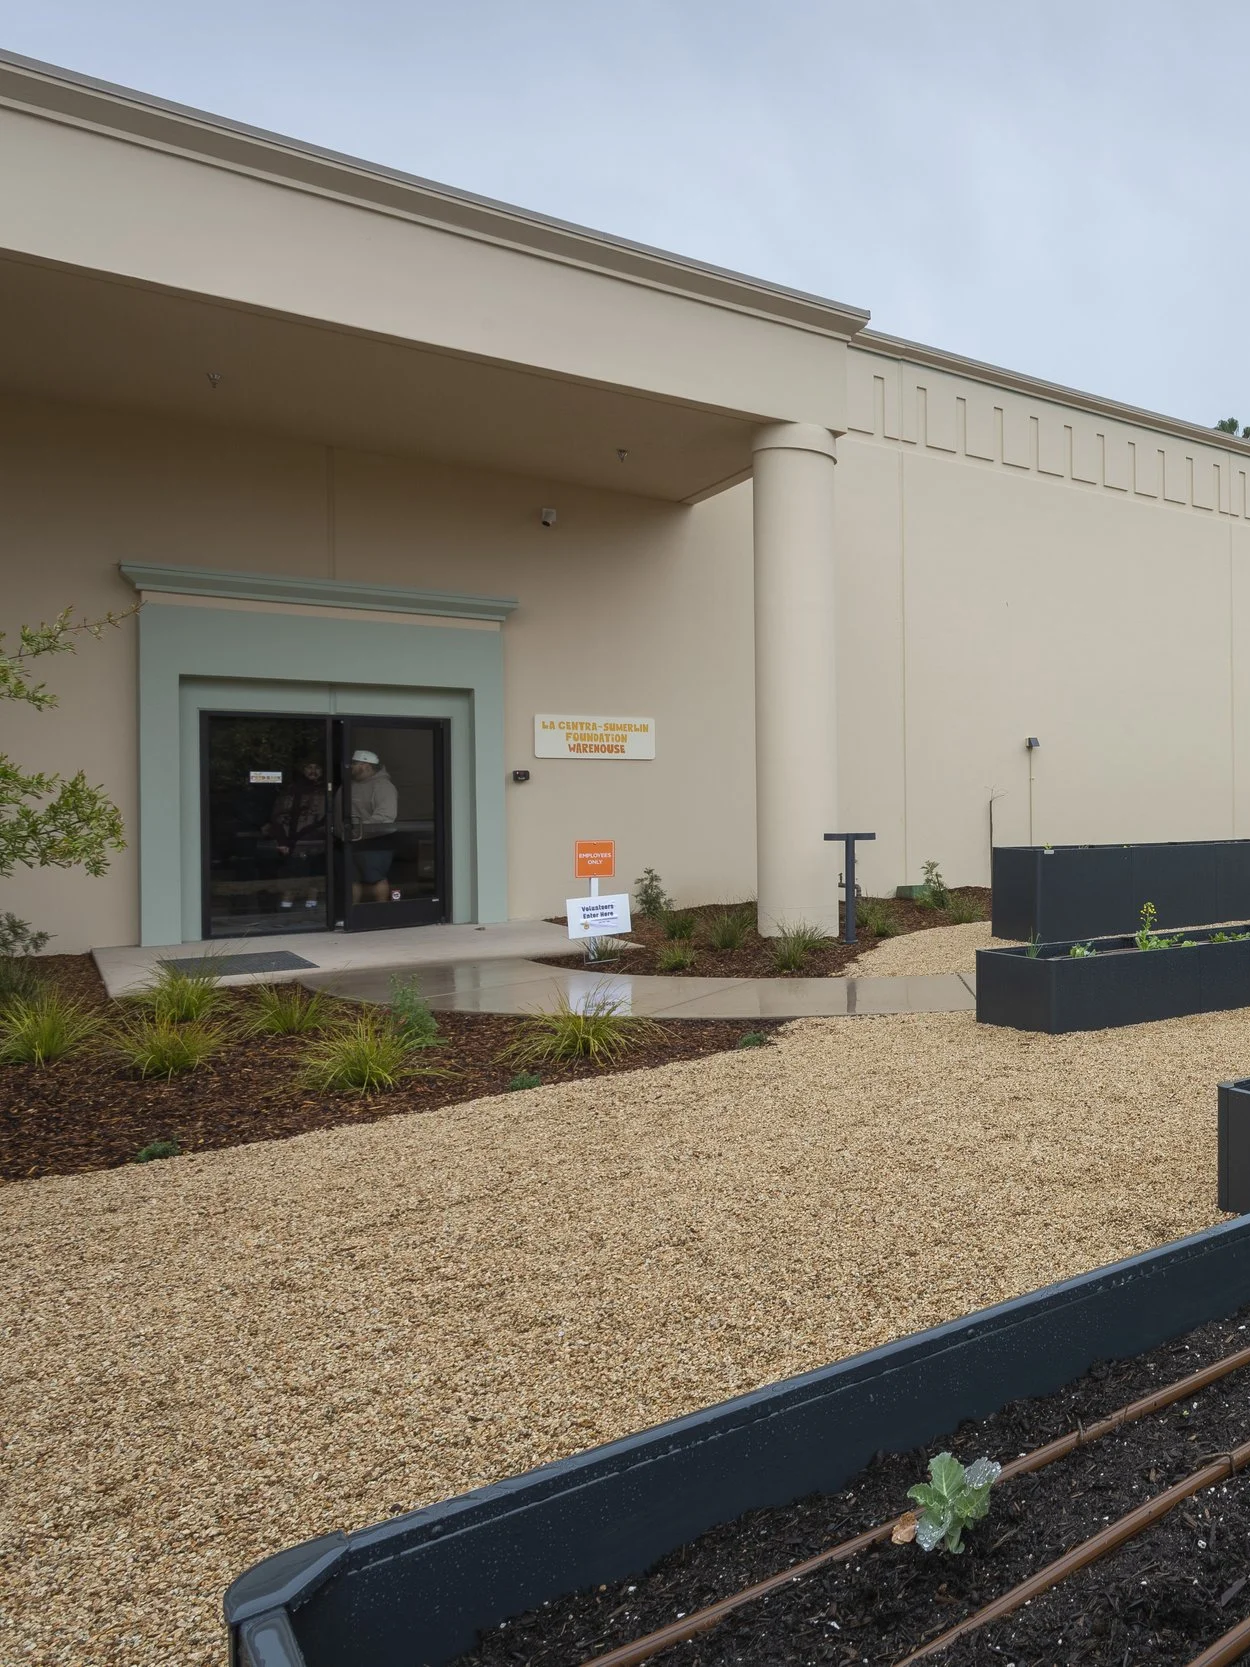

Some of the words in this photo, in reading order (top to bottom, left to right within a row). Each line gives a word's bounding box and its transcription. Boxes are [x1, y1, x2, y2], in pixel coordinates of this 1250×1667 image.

[541, 720, 556, 730] LA
[568, 743, 626, 754] WAREHOUSE
[581, 904, 614, 912] Volunteers
